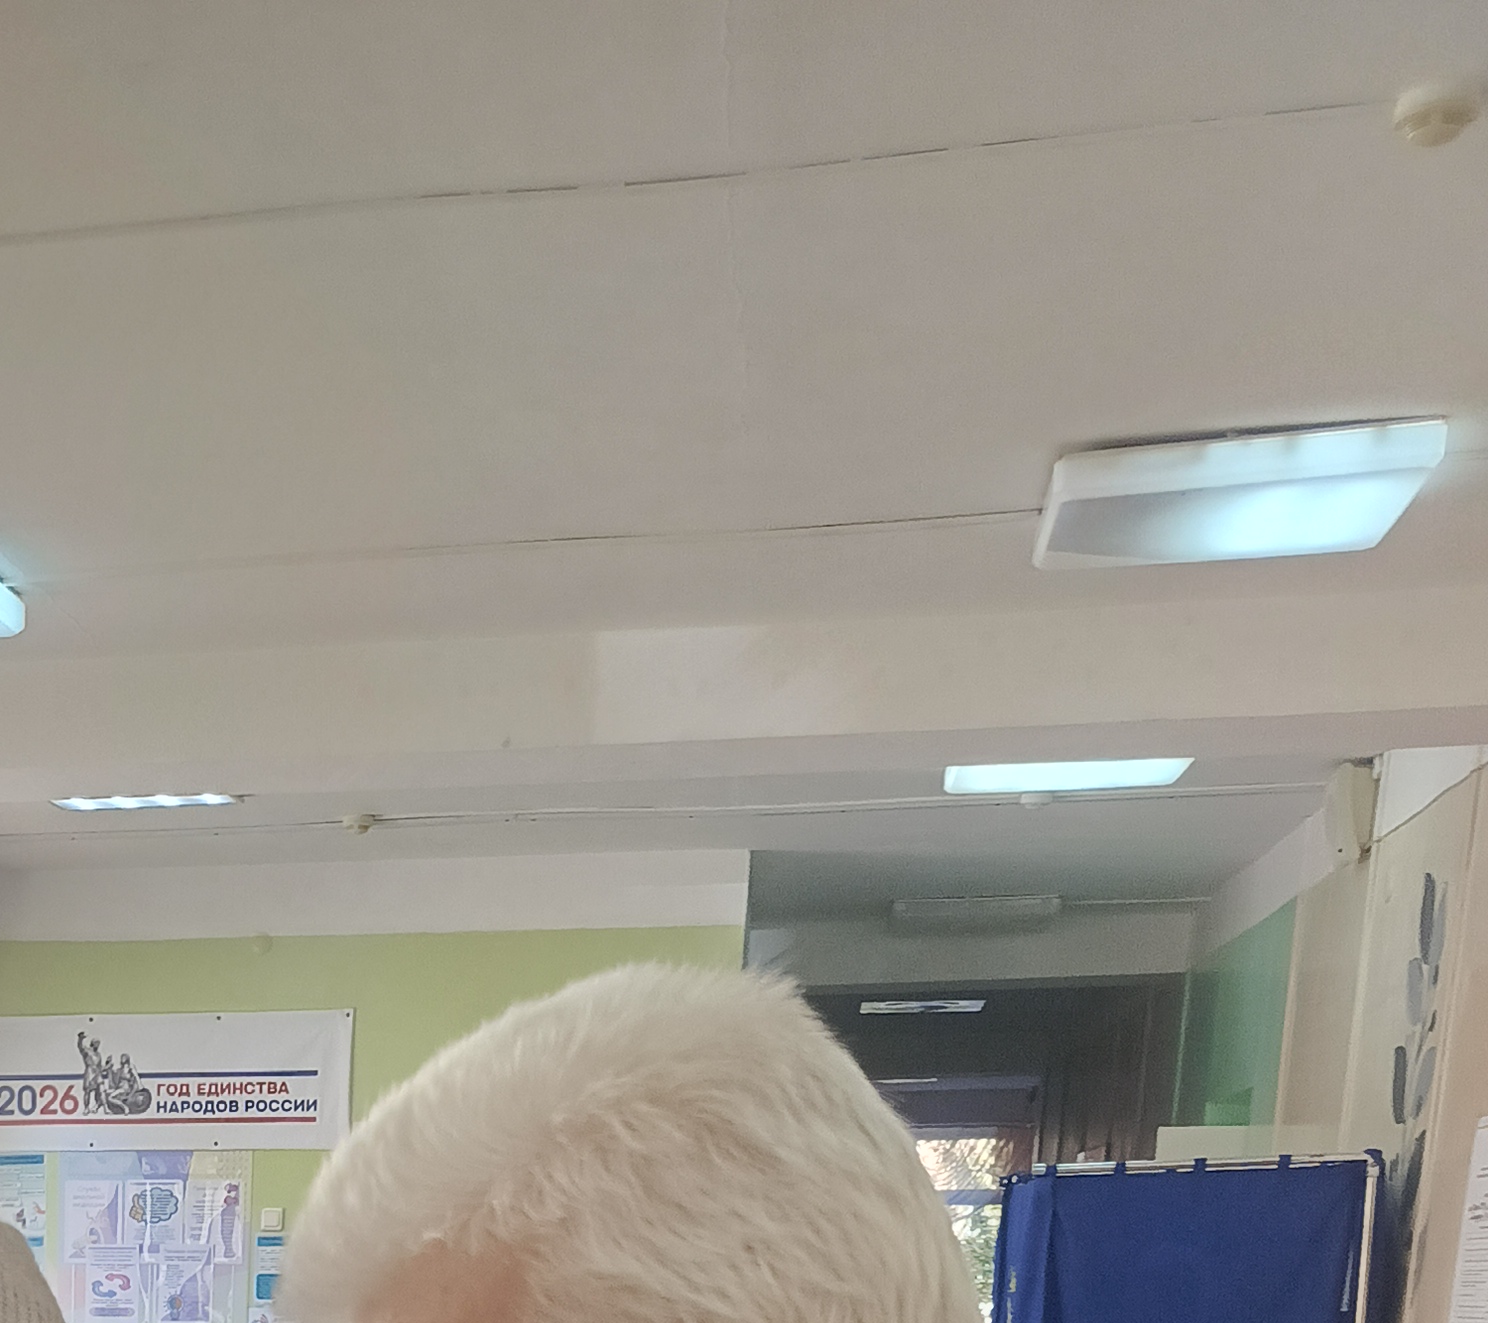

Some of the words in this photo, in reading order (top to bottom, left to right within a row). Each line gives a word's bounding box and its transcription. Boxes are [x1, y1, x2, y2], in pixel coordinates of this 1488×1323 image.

[156, 1083, 191, 1098] ГОД
[196, 1081, 290, 1098] ЕДИНСТВА
[156, 1100, 240, 1116] НАРОДОВ
[244, 1098, 318, 1113] РОССИИ
